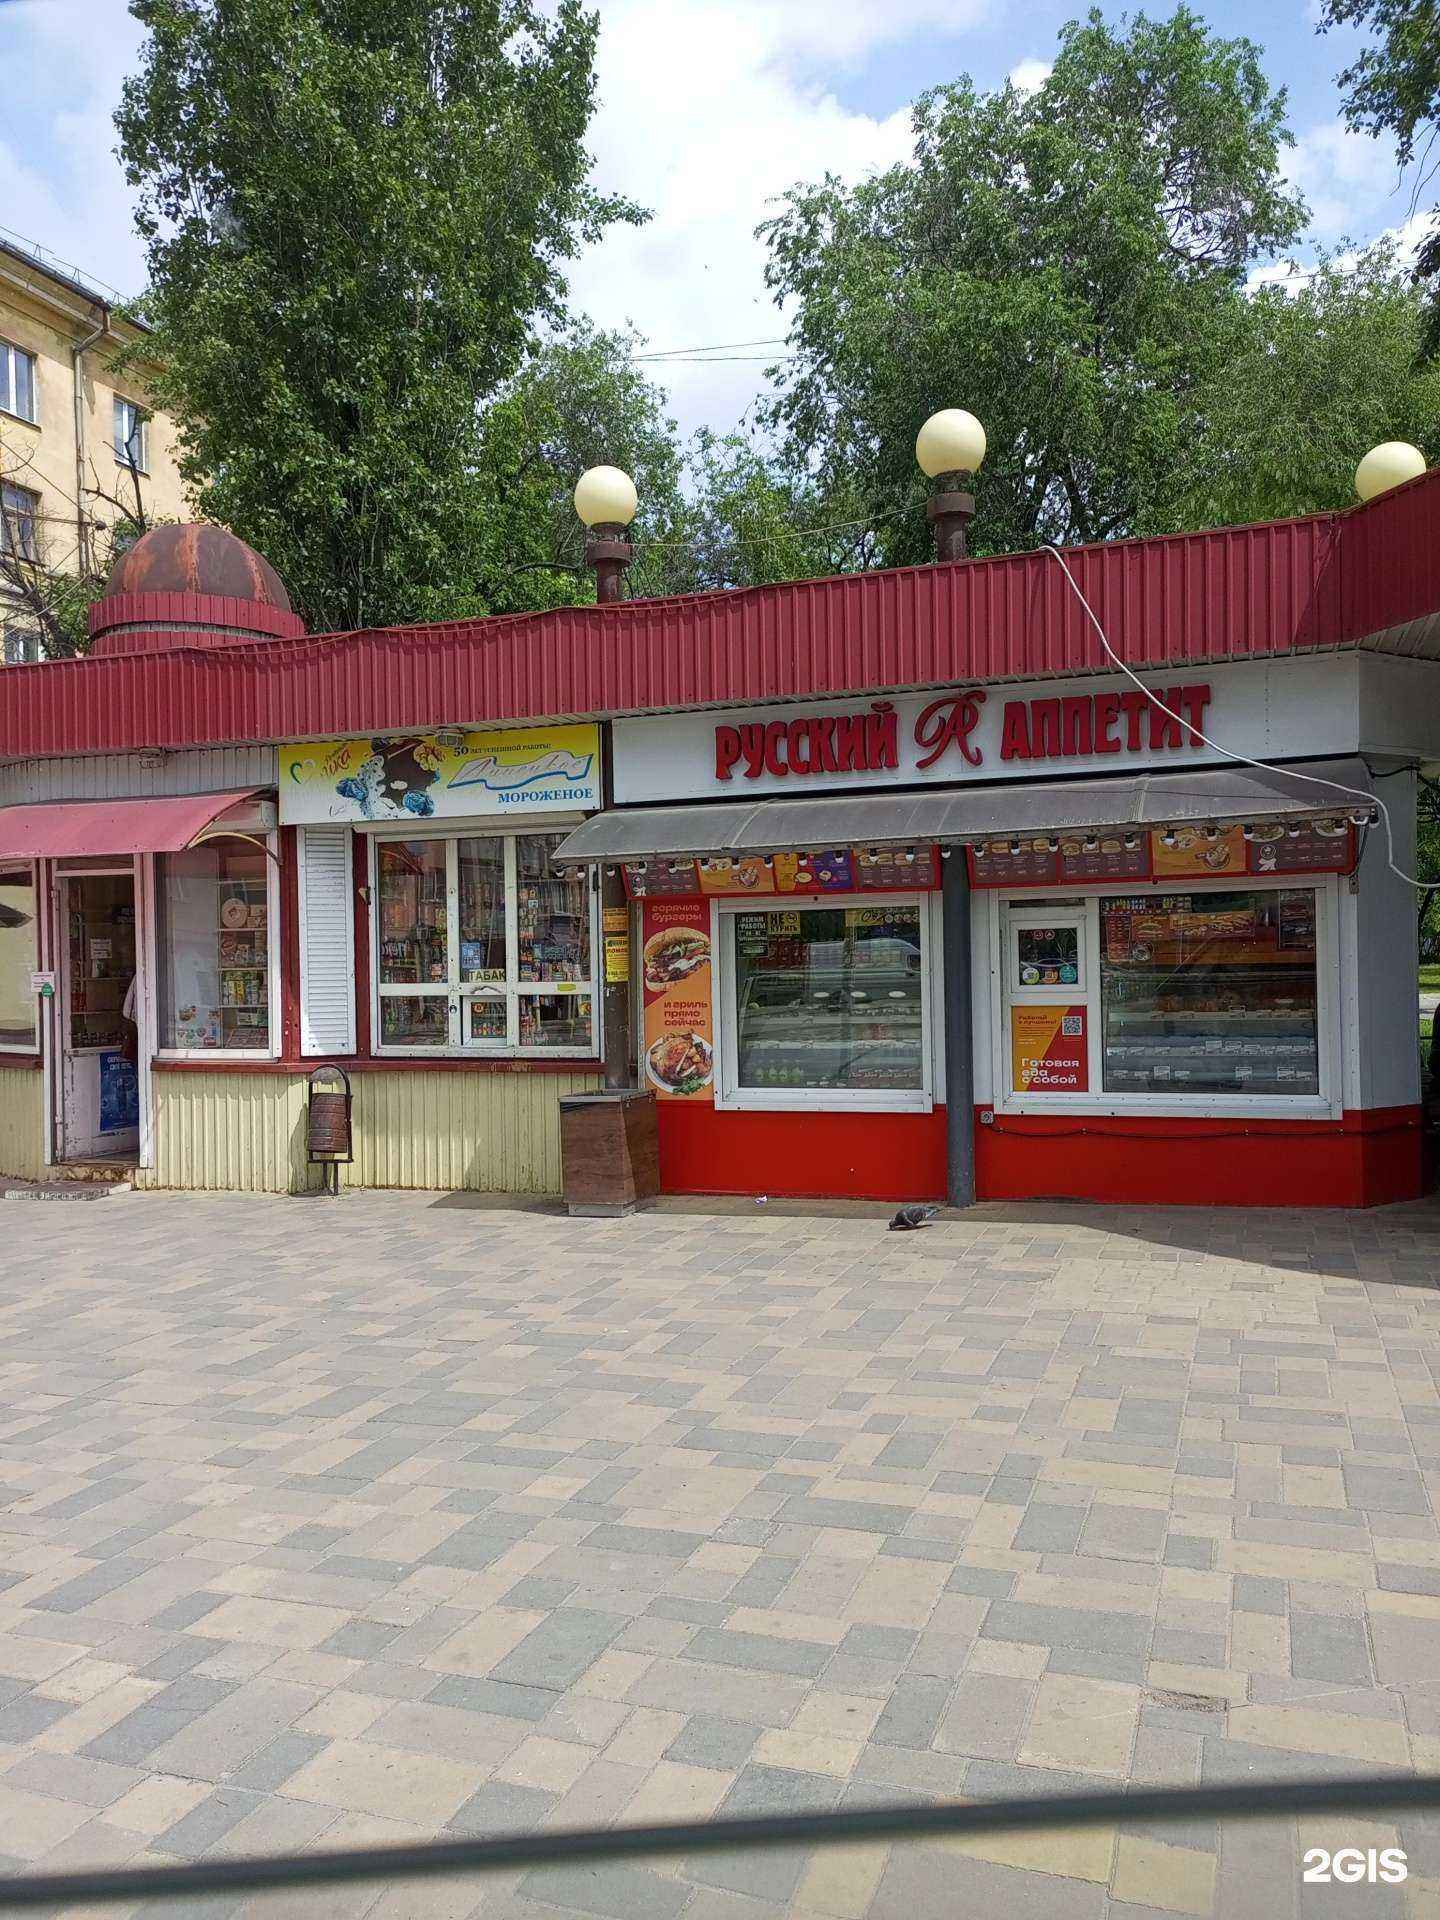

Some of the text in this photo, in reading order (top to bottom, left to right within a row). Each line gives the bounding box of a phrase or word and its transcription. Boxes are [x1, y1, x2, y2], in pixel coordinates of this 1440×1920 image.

[715, 701, 899, 780] РУССКИЙ
[1000, 684, 1211, 760] АППЕТИТ
[453, 746, 469, 757] 50
[498, 788, 593, 803] МОРОЖЕНОЕ
[652, 912, 702, 922] бургеры
[469, 970, 506, 981] ТАБАК
[673, 1001, 708, 1010] гриль
[664, 1010, 700, 1019] прямо
[664, 1017, 706, 1026] сейчас
[1022, 1058, 1080, 1067] Готовая
[1022, 1067, 1048, 1077] еда
[1033, 1074, 1077, 1084] собой
